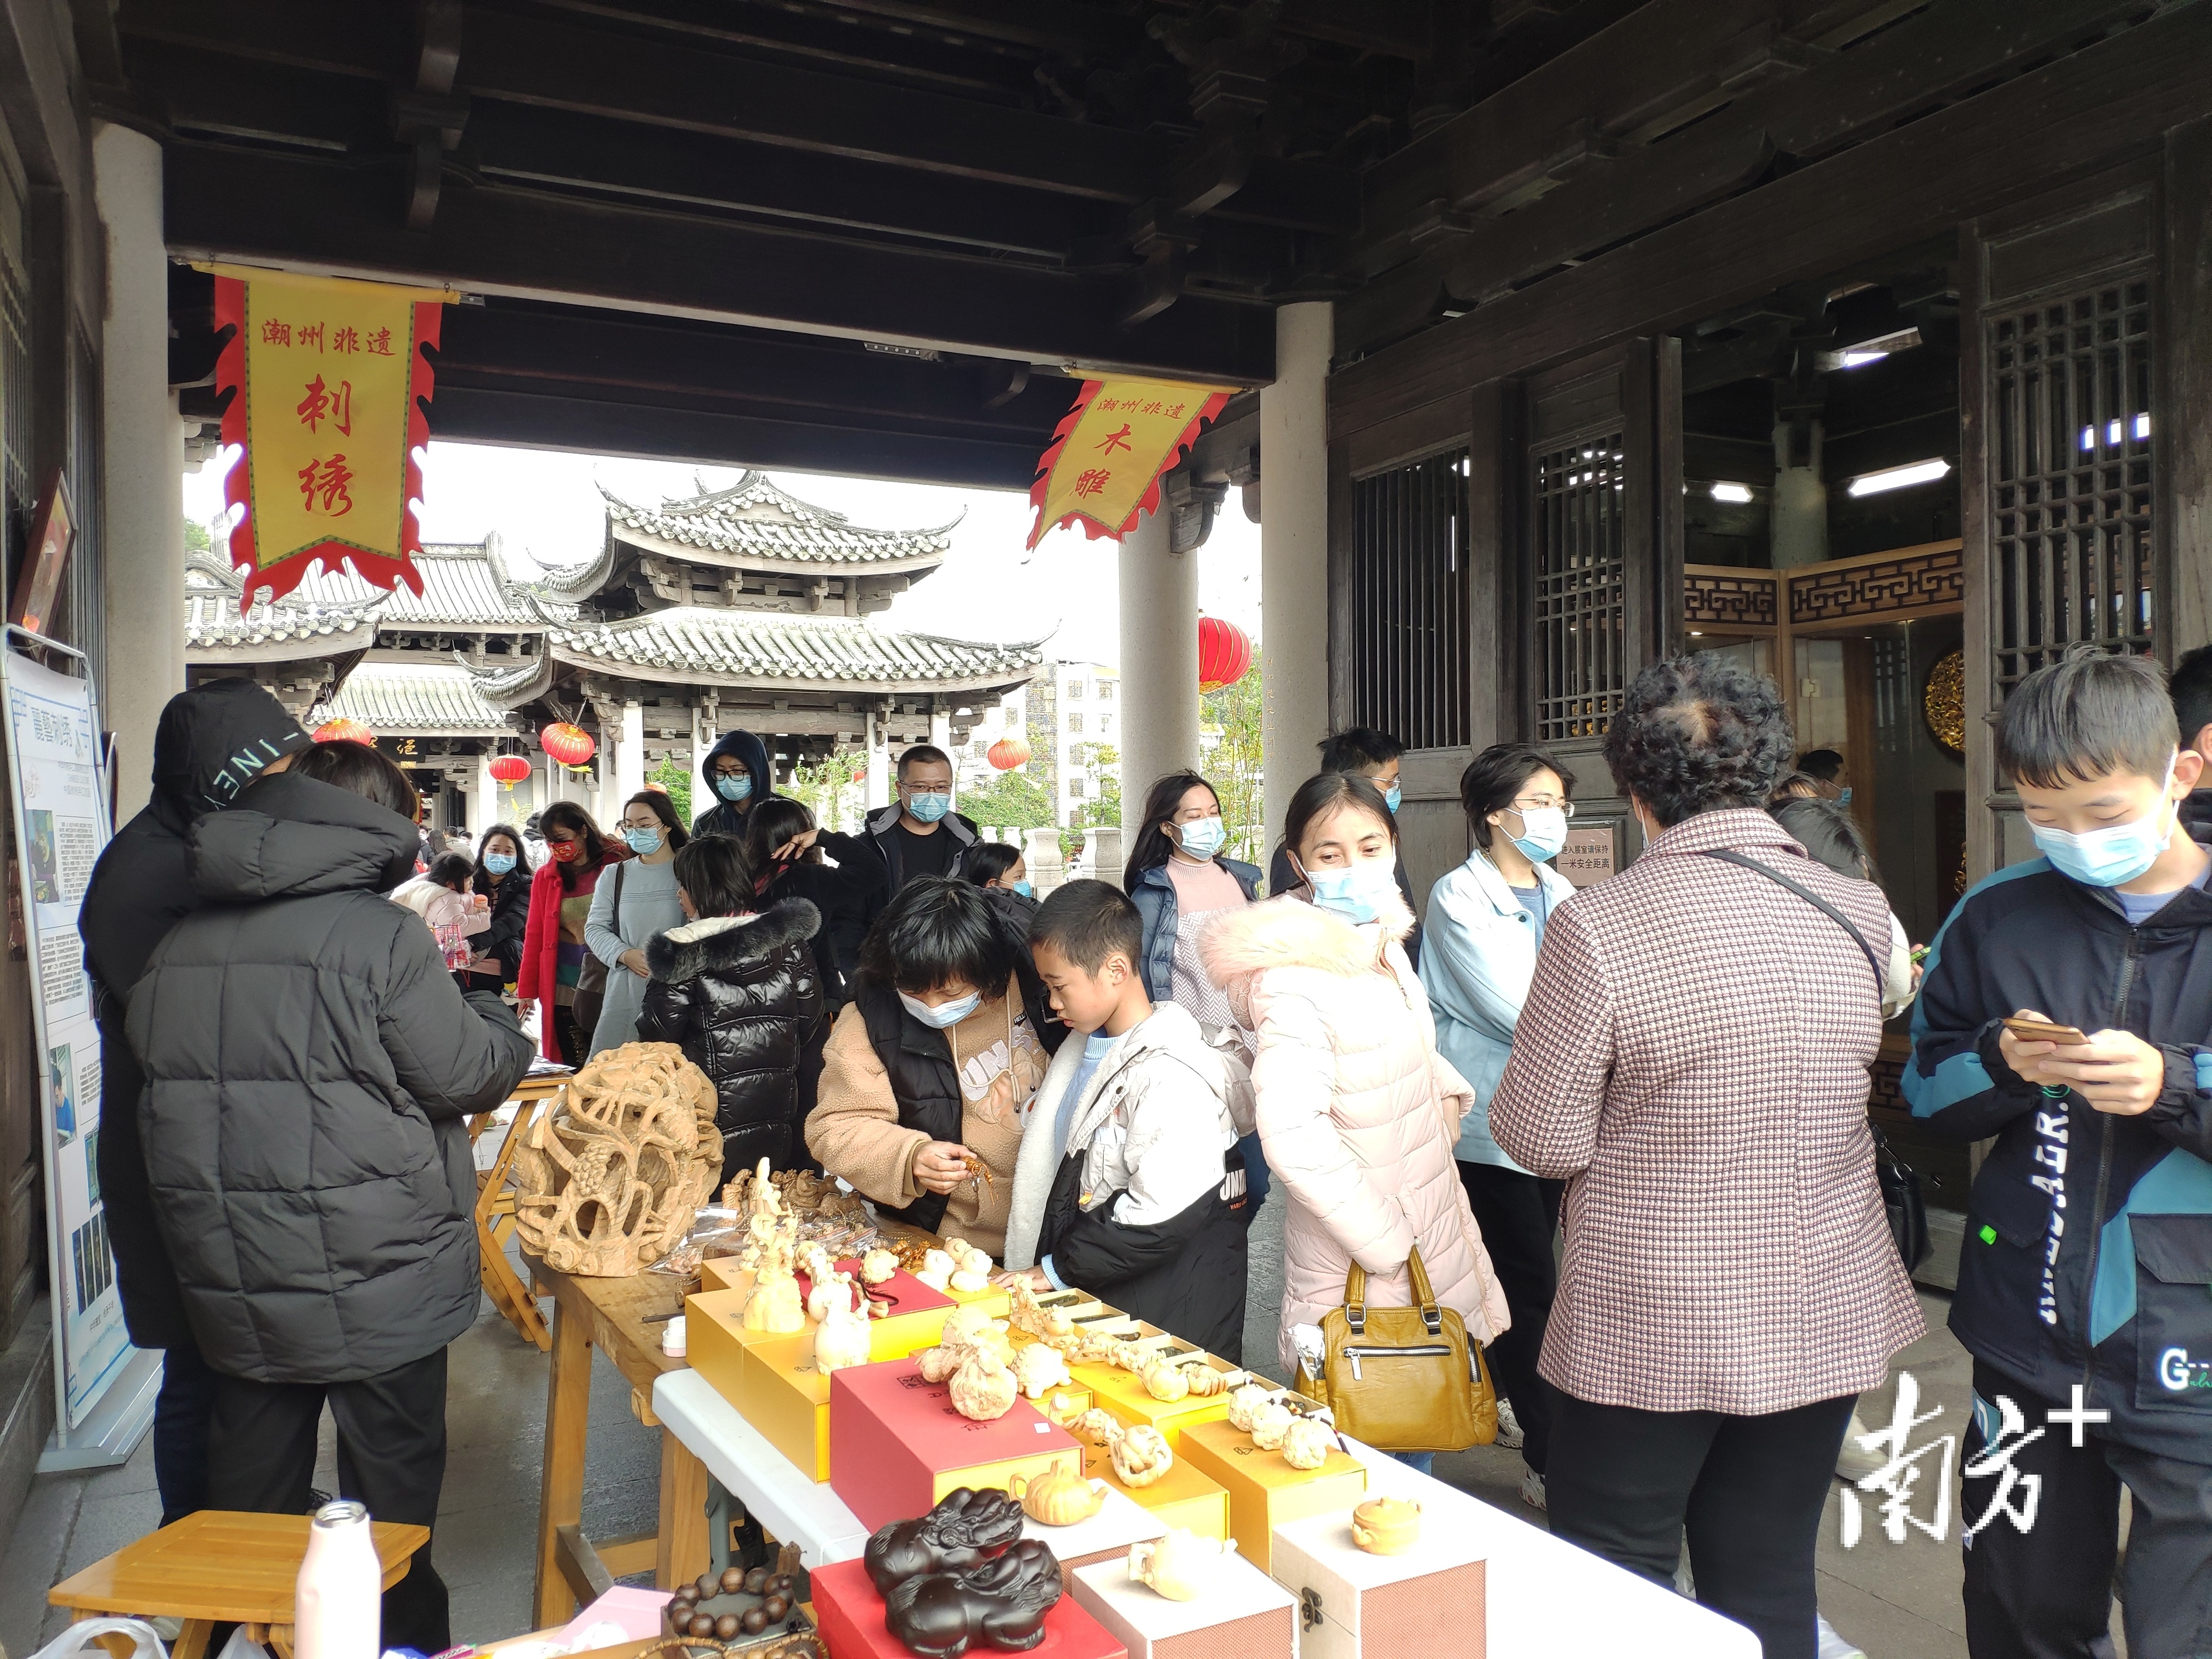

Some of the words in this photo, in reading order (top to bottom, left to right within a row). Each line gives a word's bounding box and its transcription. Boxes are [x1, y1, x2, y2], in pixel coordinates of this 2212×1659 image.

[262, 318, 396, 356] 潮州非遗
[1097, 398, 1186, 419] 潮州非遗
[297, 373, 354, 517] 刺绣
[1068, 423, 1132, 499] 木雕
[1561, 844, 1609, 855] 进入展室请保持
[1561, 857, 1610, 870] 一米安全距离
